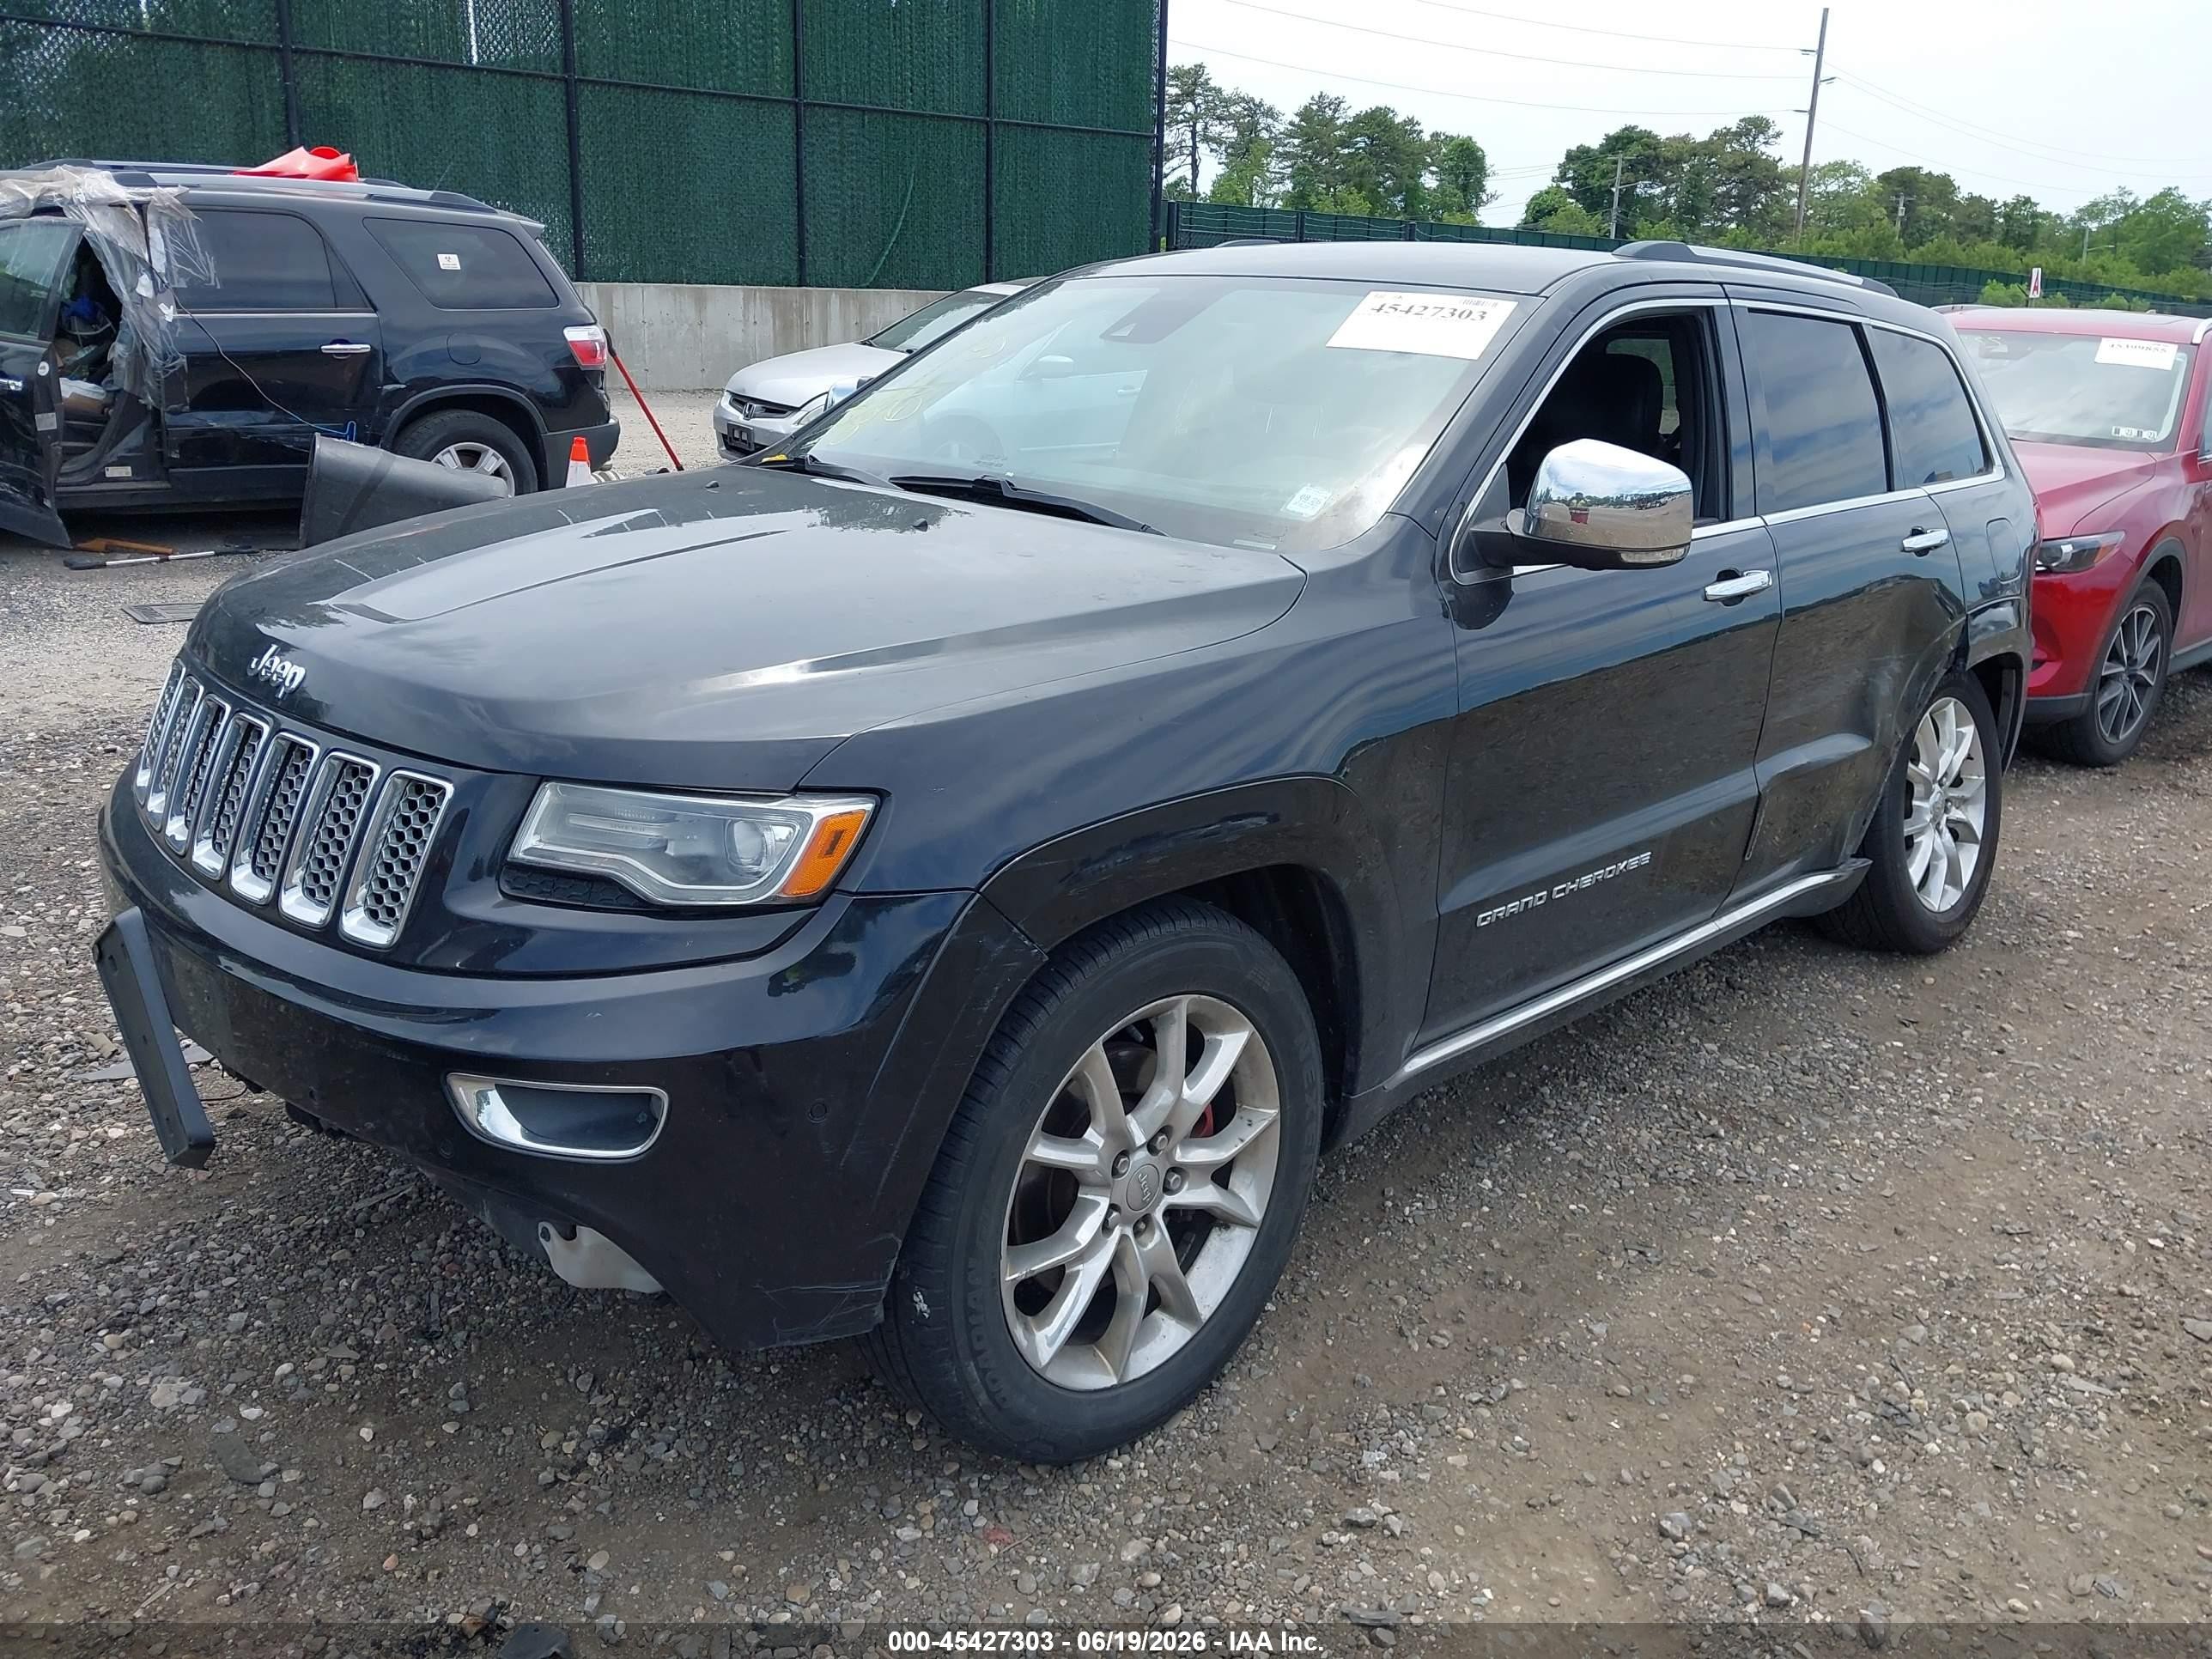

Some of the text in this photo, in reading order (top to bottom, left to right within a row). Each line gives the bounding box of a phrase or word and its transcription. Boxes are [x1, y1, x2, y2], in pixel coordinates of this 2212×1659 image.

[2032, 268, 2039, 296] A
[1371, 303, 1488, 322] 45427303
[246, 643, 307, 699] Jeep
[1476, 851, 1652, 927] GRAND CHEROKEE
[1138, 1173, 1153, 1202] Jeep
